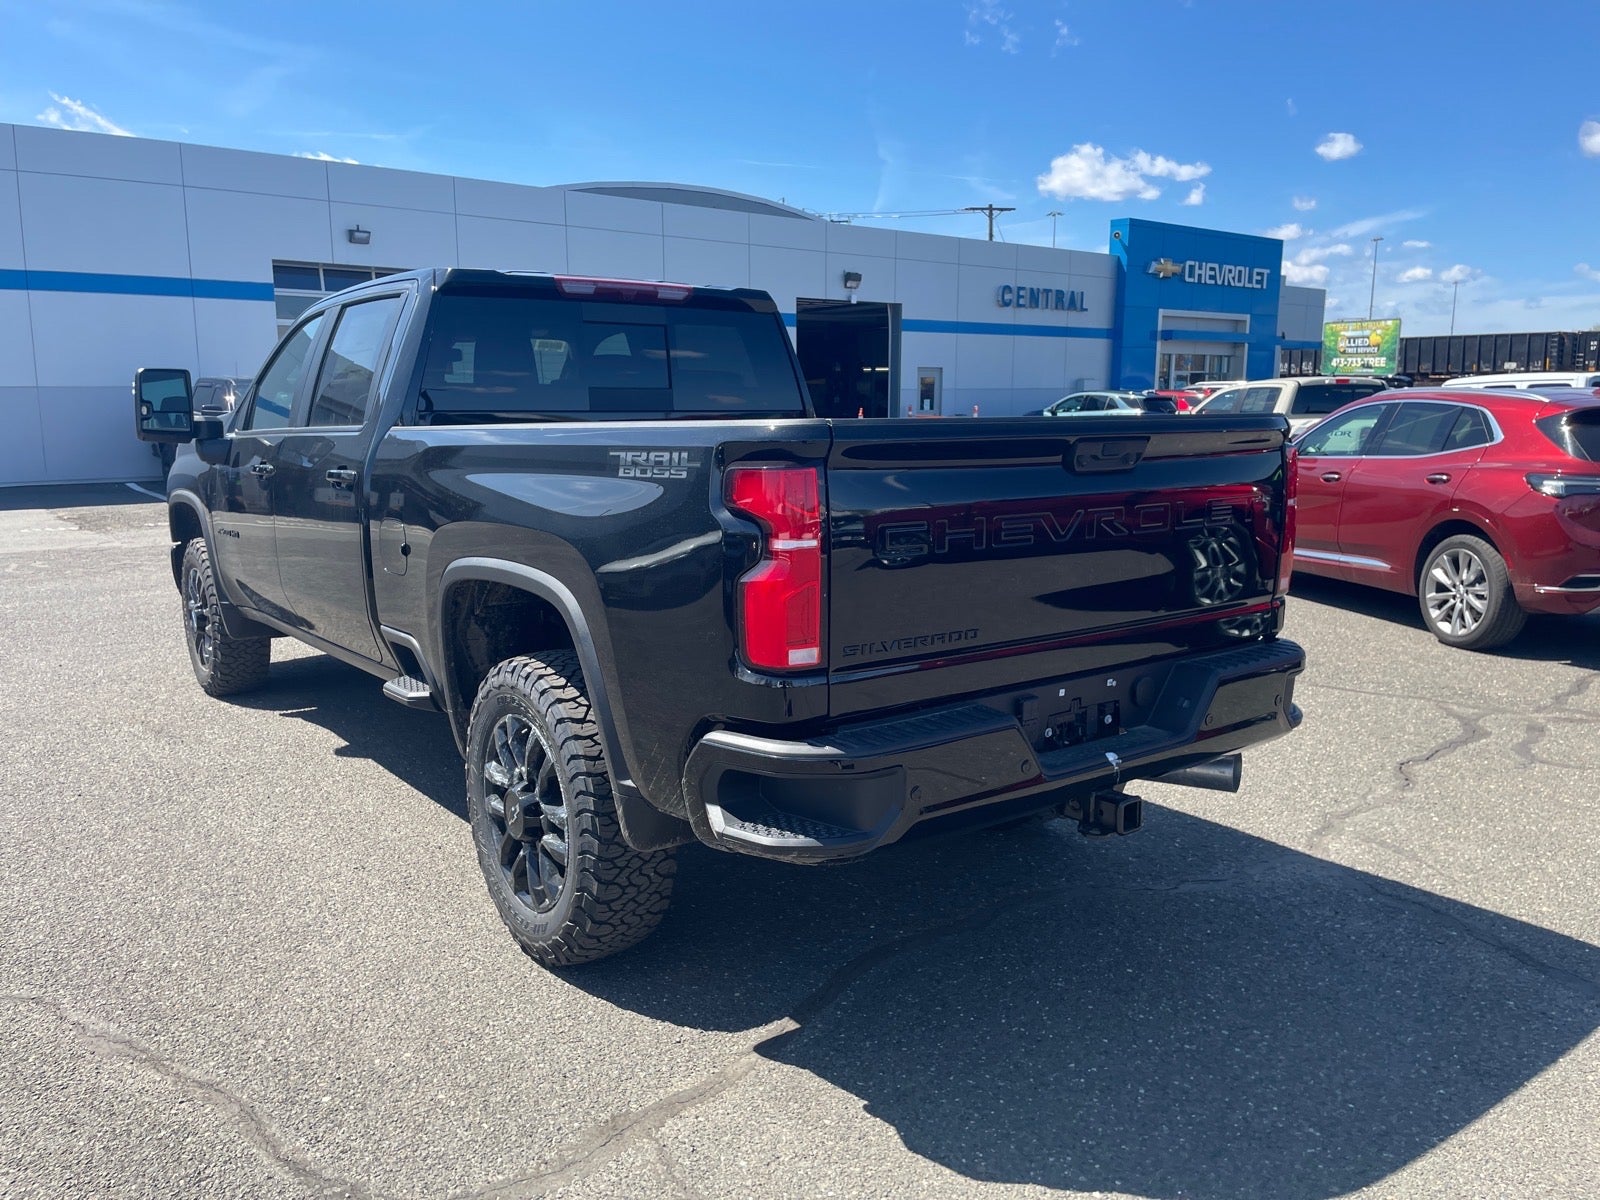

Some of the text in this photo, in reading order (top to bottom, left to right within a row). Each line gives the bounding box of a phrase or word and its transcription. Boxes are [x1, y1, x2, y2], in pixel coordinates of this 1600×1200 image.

[1184, 260, 1270, 289] CHEVROLET
[999, 284, 1089, 312] CENTRAL
[609, 451, 701, 467] TRAIL
[618, 466, 688, 479] BOSS
[843, 628, 980, 657] SILVERADO
